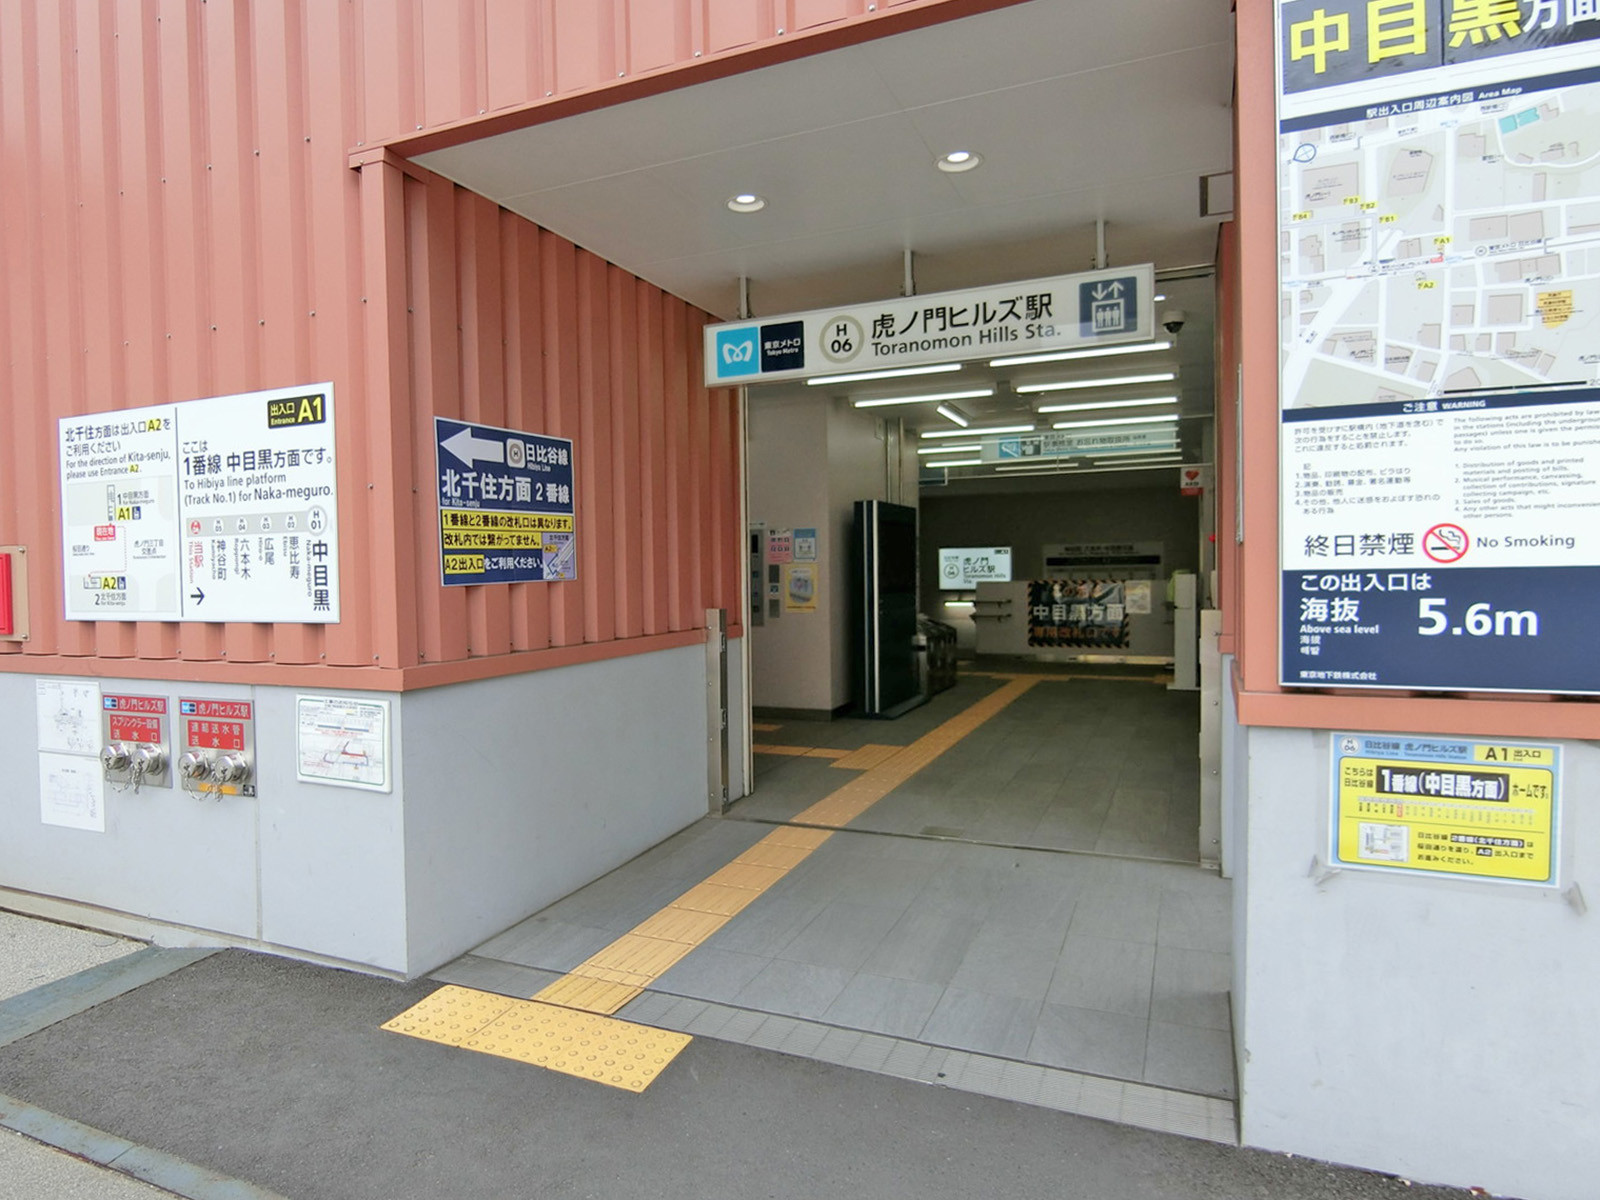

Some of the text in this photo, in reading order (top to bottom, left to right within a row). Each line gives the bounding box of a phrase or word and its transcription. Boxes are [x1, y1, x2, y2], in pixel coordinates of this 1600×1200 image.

[1366, 91, 1474, 118] 駅出入口周辺案内図
[1478, 90, 1499, 100] Area
[1502, 86, 1522, 98] Map
[871, 292, 1053, 340] 虎ノ門ヒルズ駅
[836, 324, 847, 337] H
[764, 338, 801, 350] 東京メトロ
[831, 338, 852, 354] 06
[872, 323, 1061, 356] Toranomon Hills Sta.
[270, 397, 322, 423] 出入口 A1
[1402, 400, 1486, 413] ご注意 WARNING
[270, 417, 295, 426] Entrance
[65, 419, 170, 442] 北千住方面は出入口A2を
[66, 441, 121, 456] ご利用ください
[182, 440, 208, 455] ここは
[526, 443, 569, 465] 日比谷線
[66, 460, 76, 468] For
[78, 459, 87, 468] the
[89, 457, 117, 467] direction
[128, 449, 170, 462] Kita-senju,
[183, 447, 332, 476] 1番線 中目黒方面です。
[67, 470, 86, 479] please
[100, 467, 128, 476] Entrance
[184, 473, 286, 491] To Hibiya line platform
[441, 469, 531, 502] 北千住方面
[184, 485, 334, 507] (Track No.1) for Naka-meguro.
[118, 508, 130, 520] A1
[313, 510, 319, 518] H
[311, 520, 321, 529] 01
[265, 537, 275, 565] 広尾
[1304, 532, 1576, 558] 終日禁煙 No Smoking
[194, 541, 204, 568] 当駅
[217, 540, 227, 580] 神谷町
[240, 539, 251, 580] 六本木
[289, 536, 299, 579] 恵比寿
[963, 557, 989, 565] 虎ノ門
[312, 539, 330, 611] 中目黒
[963, 565, 996, 573] ヒルズ駅
[103, 577, 116, 590] A2
[1301, 572, 1432, 592] この出入口は
[95, 594, 100, 605] 2
[1033, 603, 1125, 621] 中目黒方面
[1300, 597, 1538, 636] 海抜 5.6m
[1300, 625, 1331, 633] Above
[1354, 625, 1379, 633] level
[1300, 671, 1377, 680] 東京地下鉄株式会社
[120, 698, 164, 711] 虎ノ門ヒルズ駅
[199, 703, 249, 718] 虎ノ門ヒルズ駅
[112, 716, 158, 729] スプリンクラー設備
[1365, 740, 1400, 750] 日比谷線
[1405, 742, 1468, 754] 虎ノ門ヒルズ駅
[1485, 747, 1507, 761] A1
[1514, 749, 1541, 758] 出入口
[1345, 767, 1373, 776] こちらは
[1345, 778, 1373, 788] 日比谷線
[1418, 832, 1448, 840] 日比谷線
